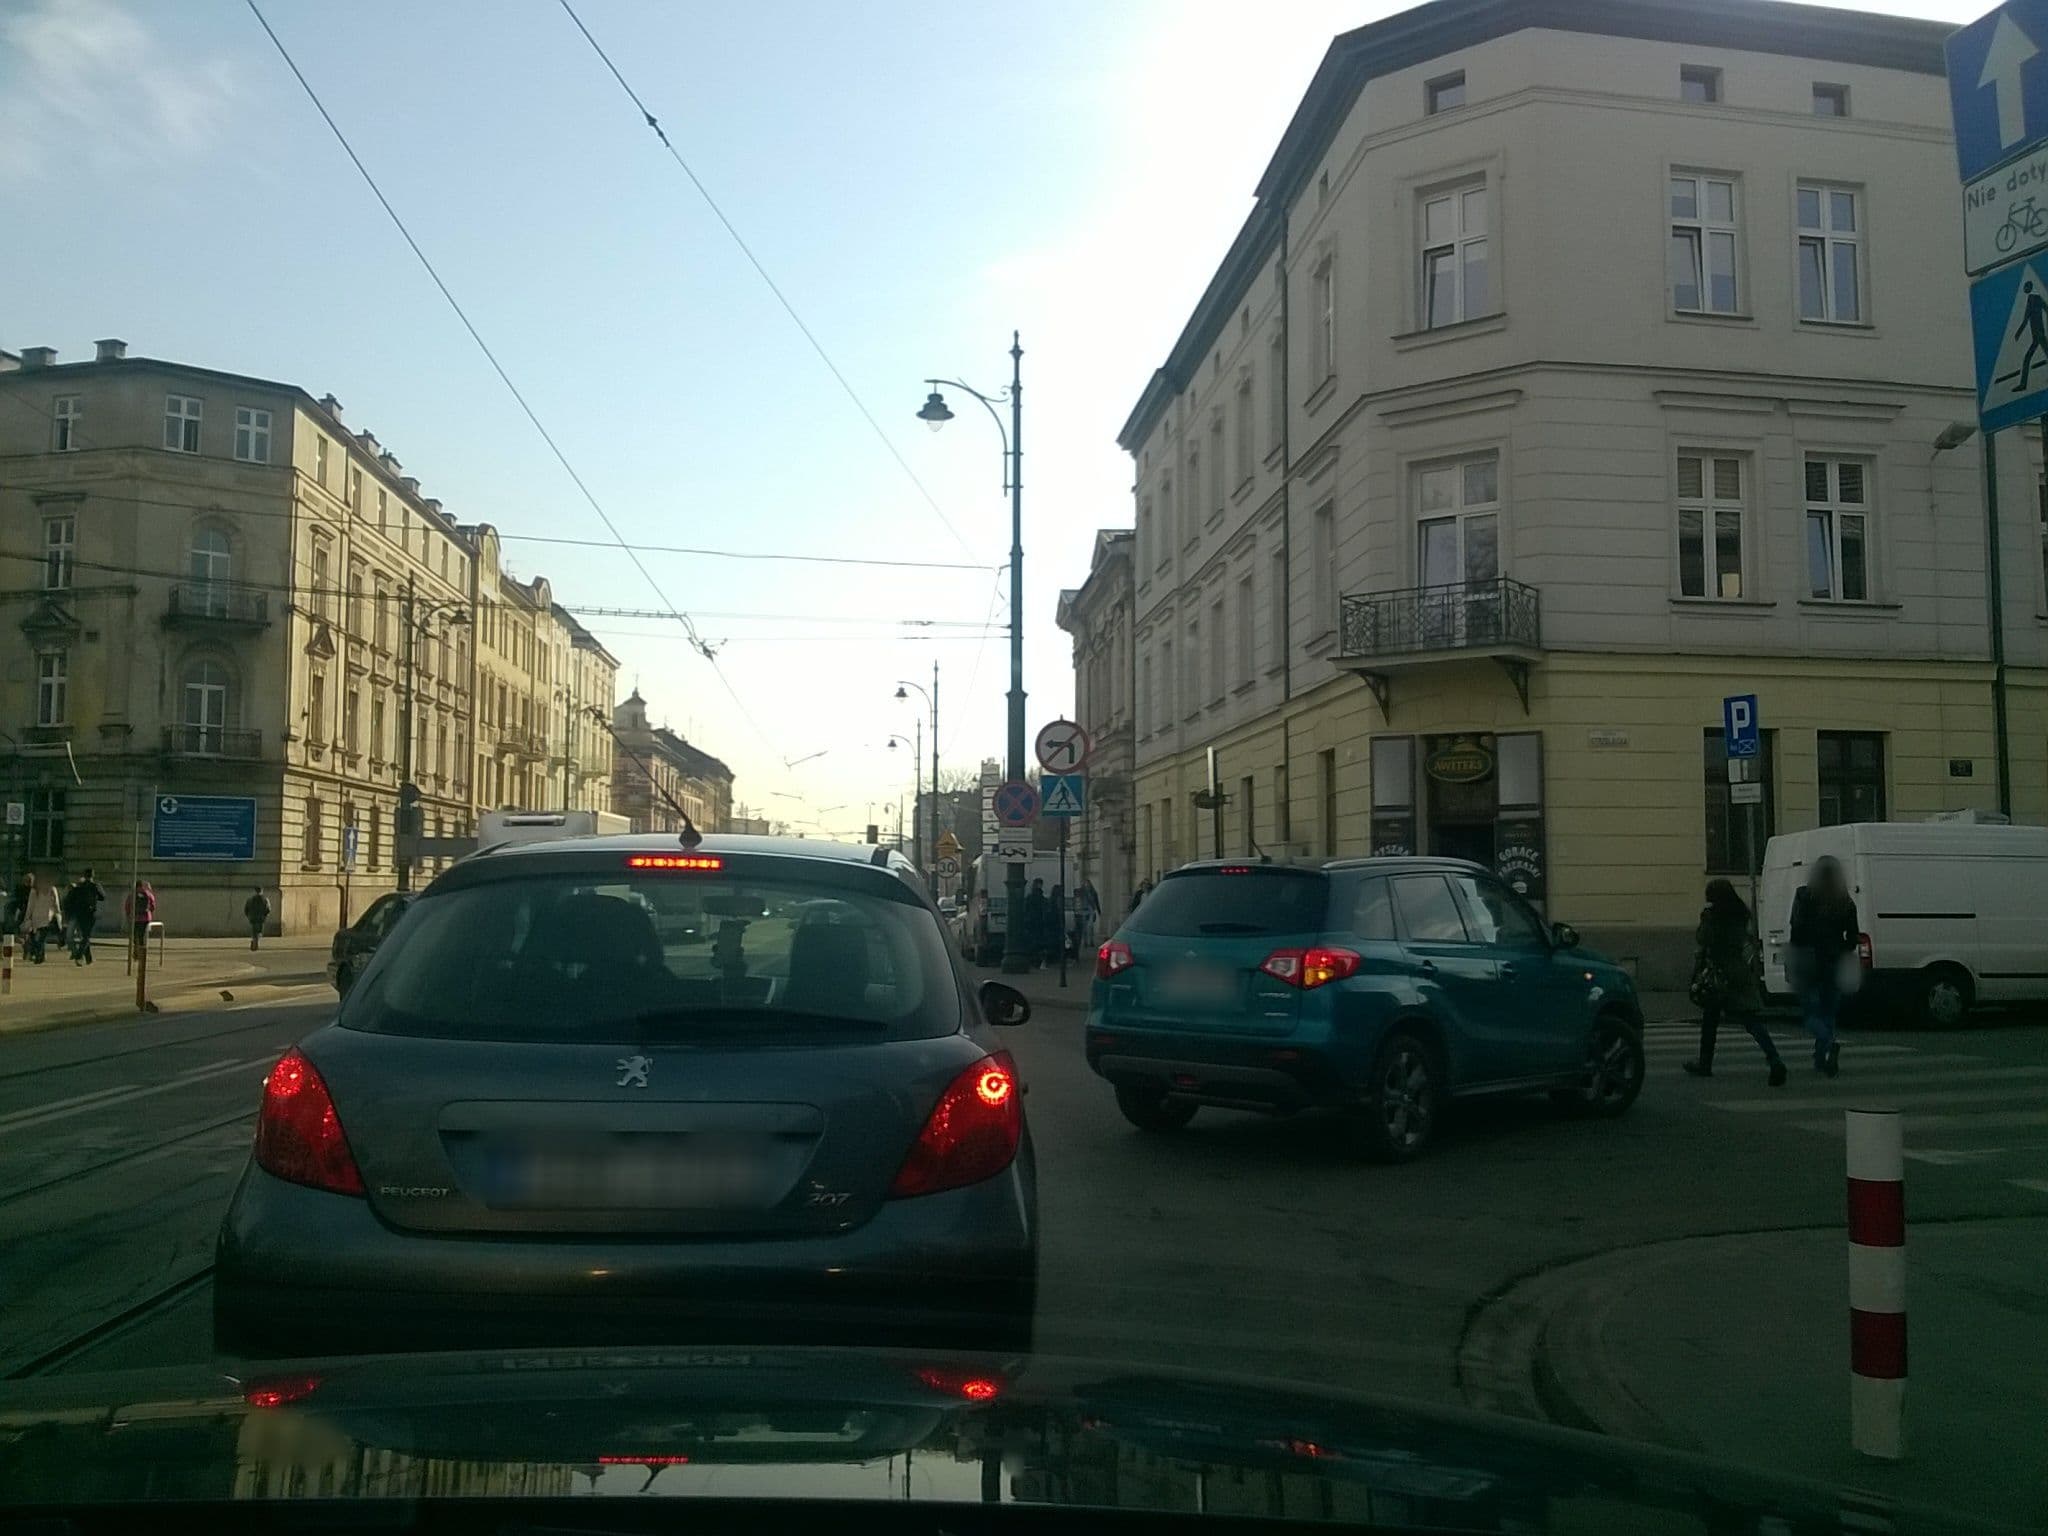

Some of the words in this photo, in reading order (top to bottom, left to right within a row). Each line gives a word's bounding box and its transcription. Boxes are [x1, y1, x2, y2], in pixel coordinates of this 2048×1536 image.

[1967, 184, 1997, 213] Nie
[1730, 700, 1751, 740] P
[939, 862, 955, 873] 30
[380, 1186, 449, 1198] PEUGEOT
